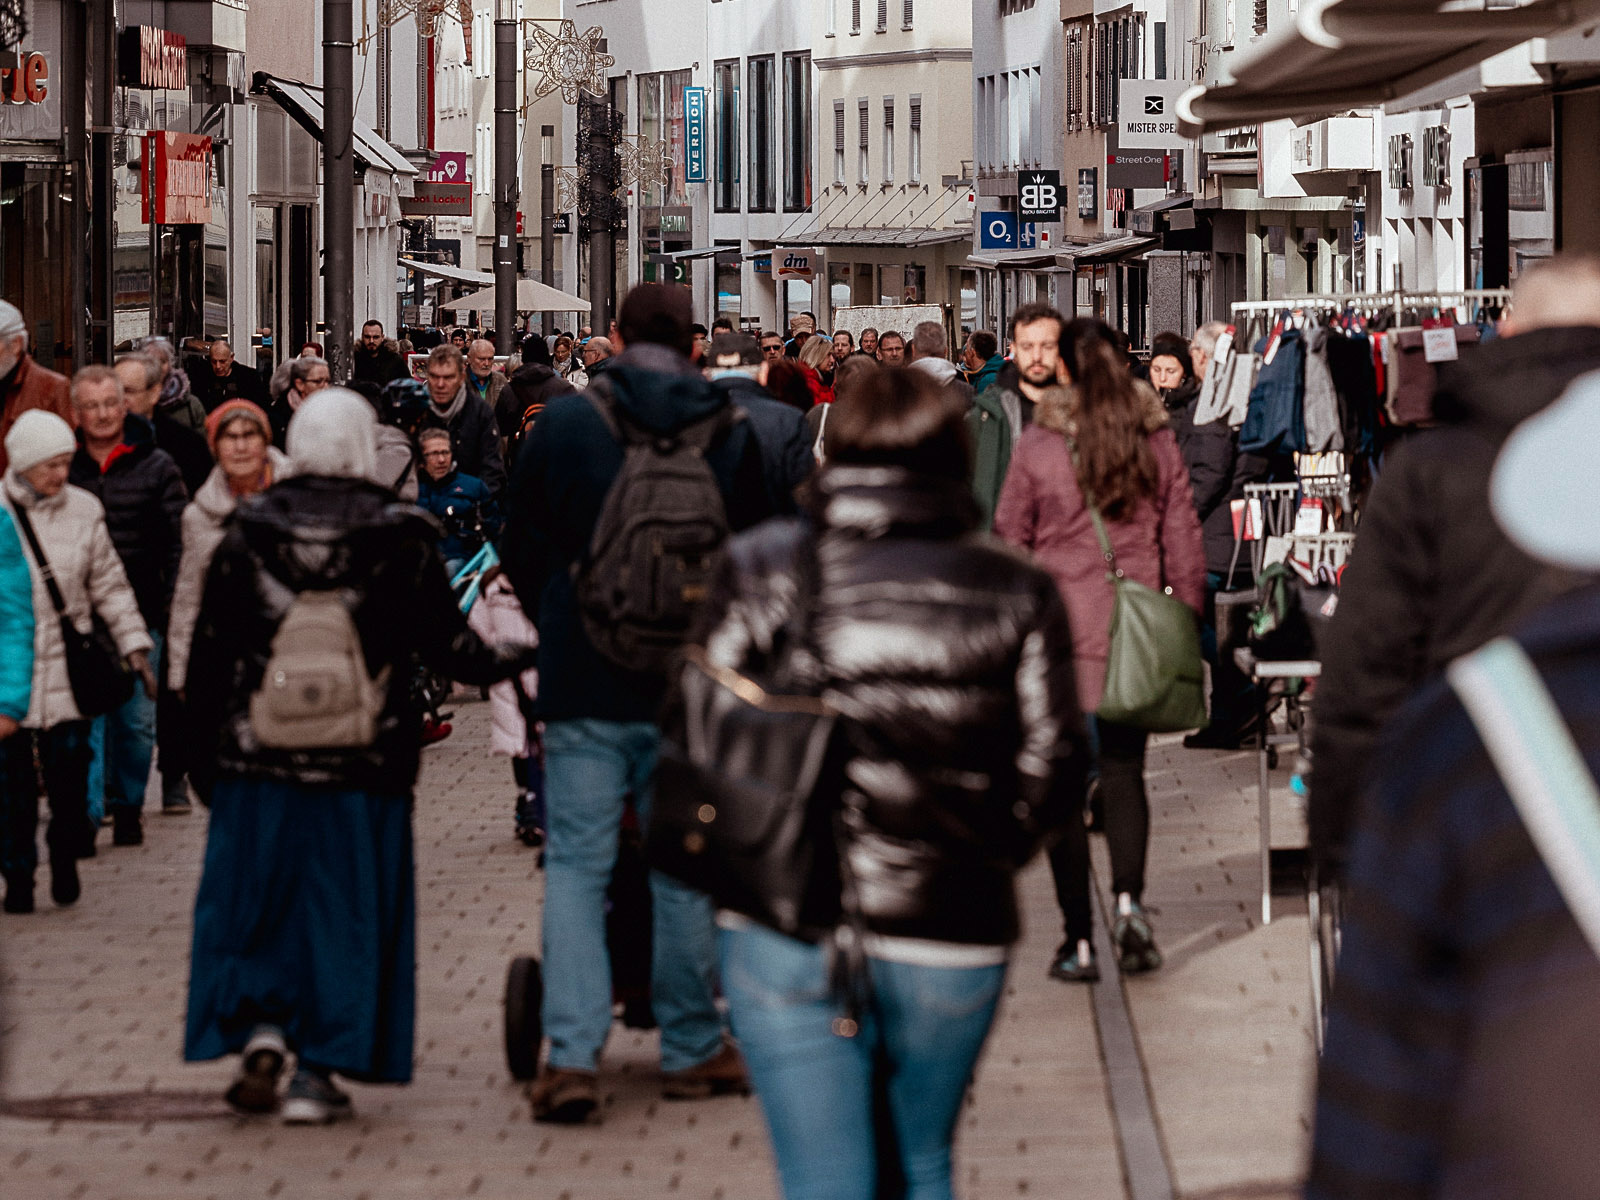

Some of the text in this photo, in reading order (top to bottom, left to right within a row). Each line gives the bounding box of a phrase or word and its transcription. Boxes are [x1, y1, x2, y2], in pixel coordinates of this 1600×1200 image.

[690, 95, 700, 173] WERDICH
[1127, 122, 1177, 134] MISTER SPE
[1115, 155, 1162, 164] Street One
[432, 194, 466, 204] Locker
[783, 253, 808, 268] dm
